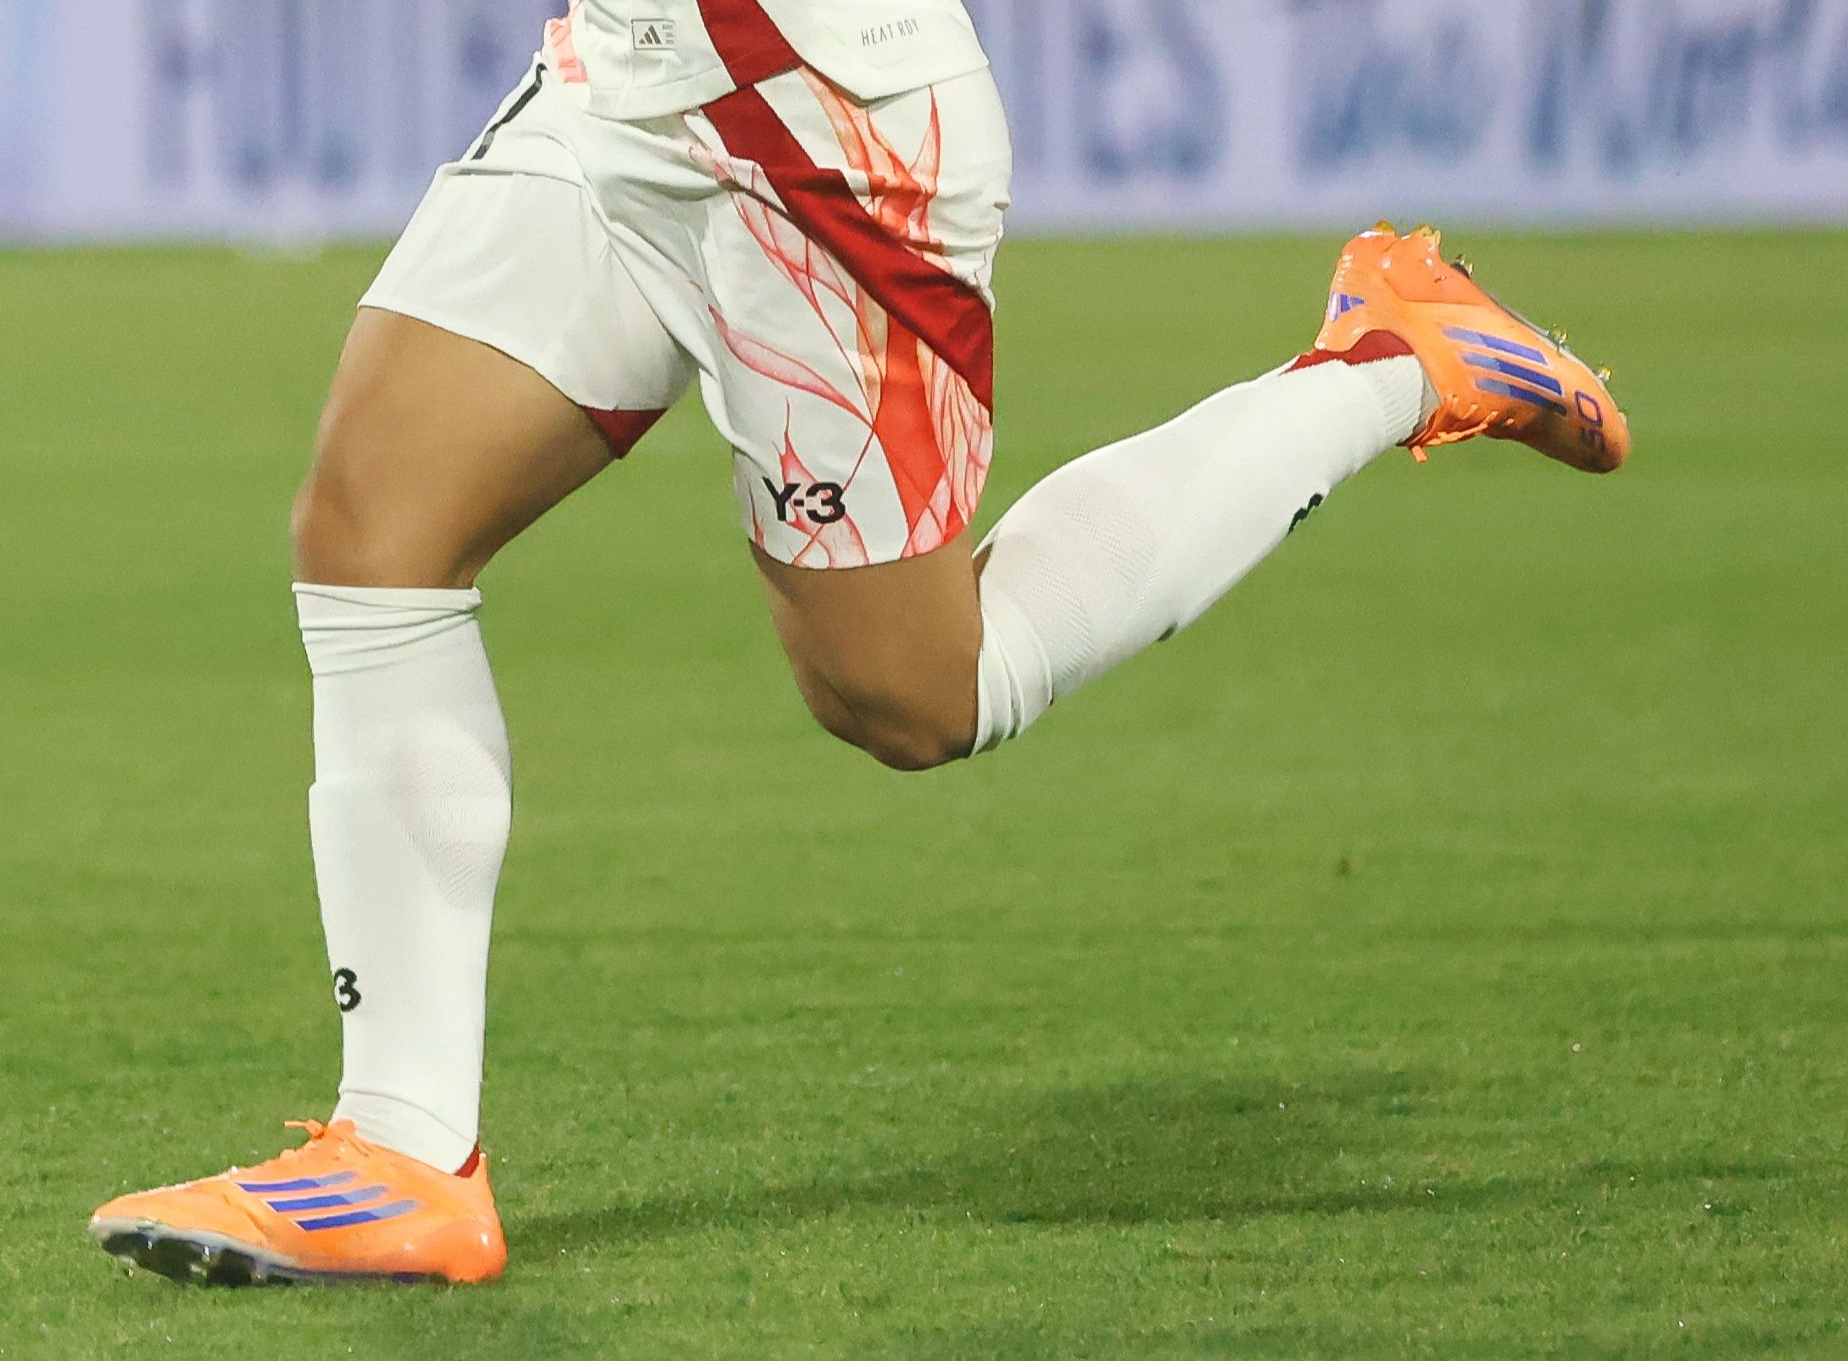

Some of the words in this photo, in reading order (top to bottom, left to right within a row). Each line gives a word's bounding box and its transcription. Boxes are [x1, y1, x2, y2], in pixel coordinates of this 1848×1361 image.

[860, 22, 894, 48] HEAT
[896, 16, 920, 38] RDY
[762, 476, 847, 524] Y-3
